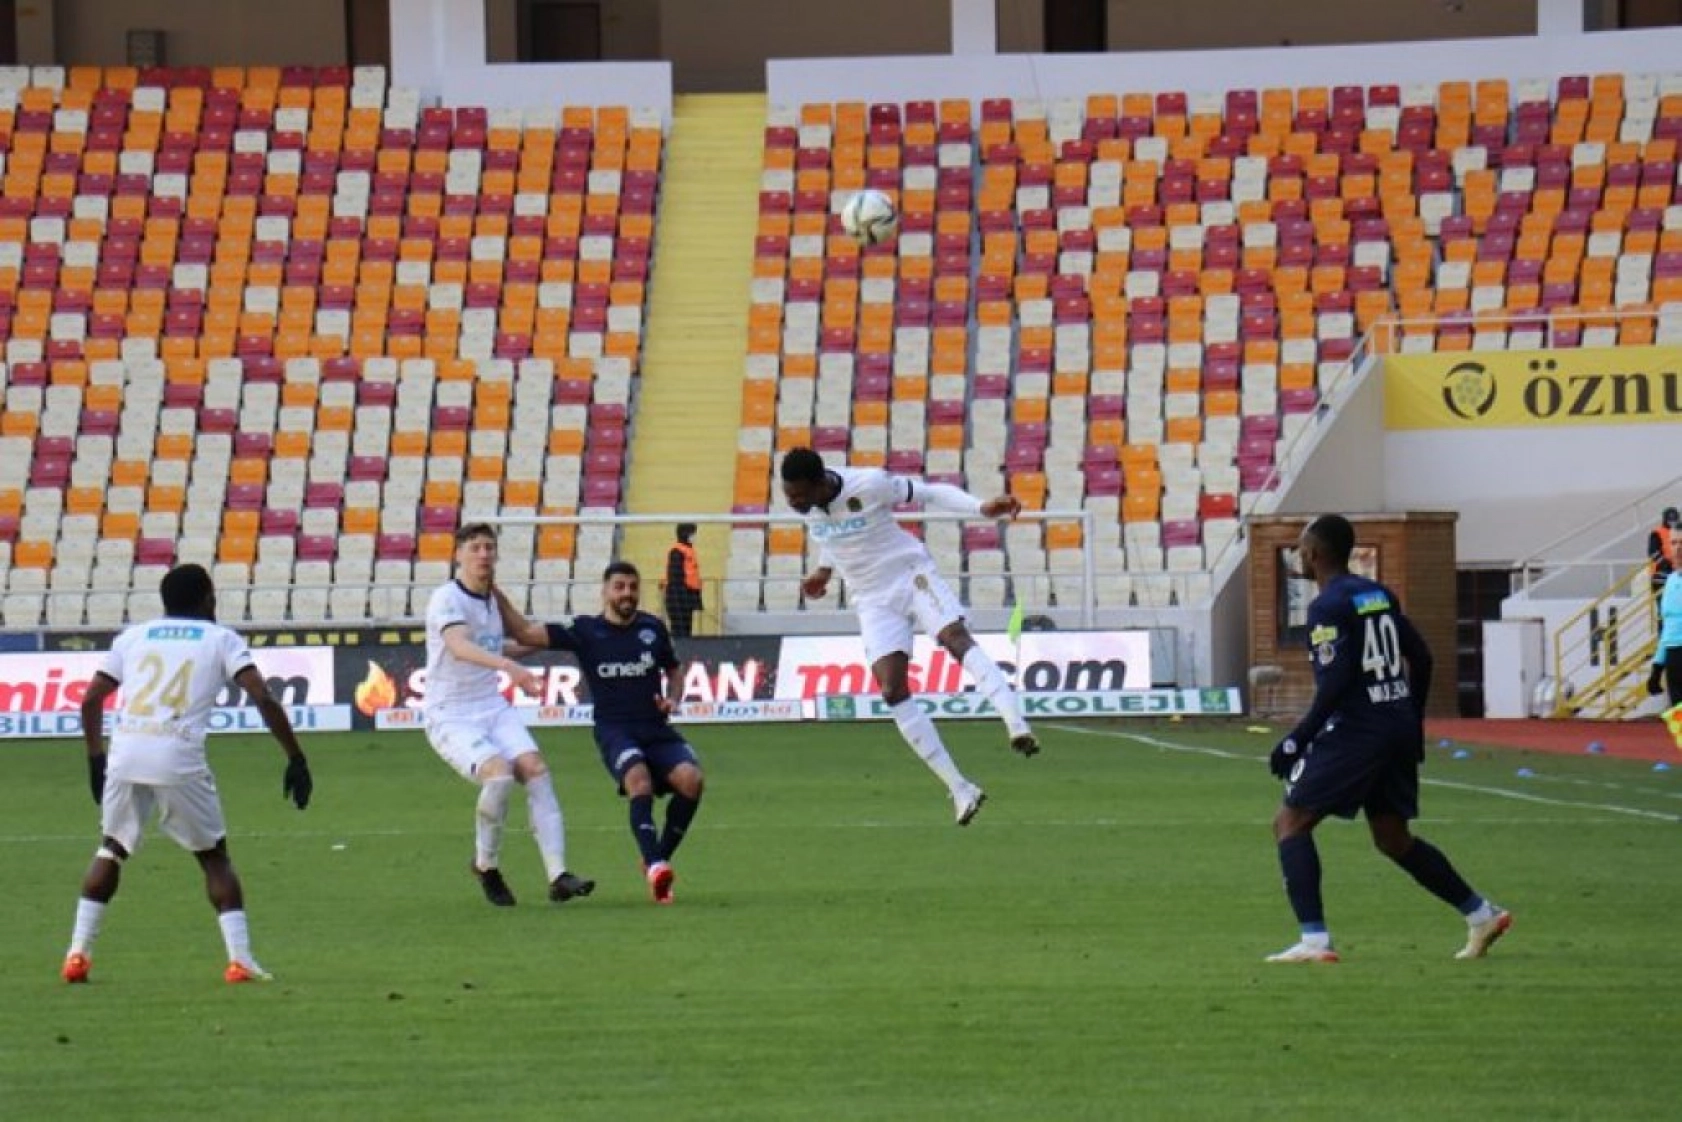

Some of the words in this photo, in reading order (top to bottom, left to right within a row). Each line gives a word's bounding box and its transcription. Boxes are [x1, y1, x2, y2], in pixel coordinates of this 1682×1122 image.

[1362, 614, 1400, 680] 40
[128, 653, 195, 717] 24
[1025, 690, 1186, 713] KOLEJİ
